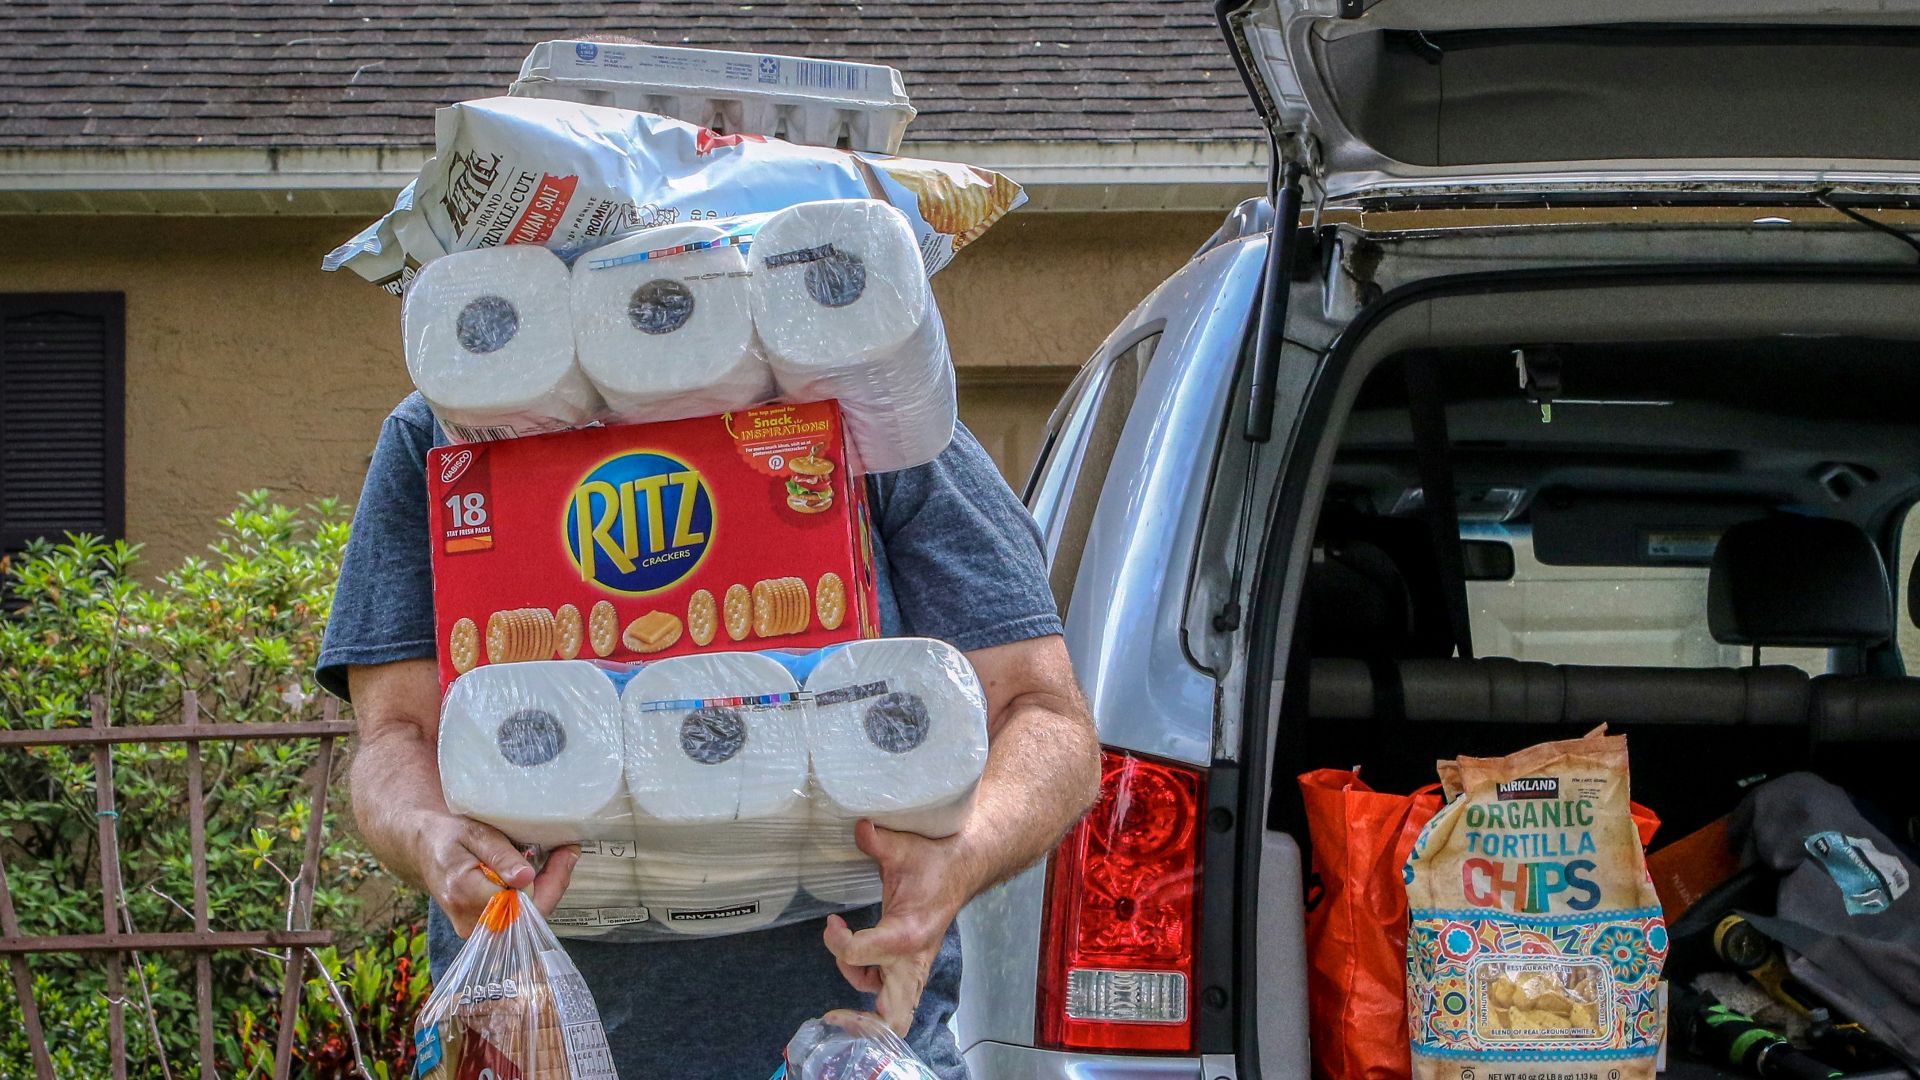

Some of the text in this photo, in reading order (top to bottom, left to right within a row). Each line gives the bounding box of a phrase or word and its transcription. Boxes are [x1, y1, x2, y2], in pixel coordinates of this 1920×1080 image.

[477, 193, 503, 227] BRAND
[536, 184, 561, 211] SALT
[573, 196, 598, 229] PROMISE
[586, 199, 613, 236] PROMISE
[741, 420, 829, 440] INSPIRATIONS!
[754, 414, 793, 428] Snack
[443, 452, 470, 480] NABISCO
[445, 492, 487, 528] 18
[446, 526, 491, 538] STAY FRESH PACKS
[576, 470, 704, 582] RITZ
[642, 549, 691, 568] CRACKERS
[1500, 779, 1557, 793] KIRKLAND
[1466, 800, 1594, 829] ORGANIC
[1466, 831, 1597, 857] TORTILLA
[1461, 857, 1602, 914] CHIPS
[675, 908, 751, 920] KIRKLAND
[1506, 964, 1553, 972] RESTAURANT
